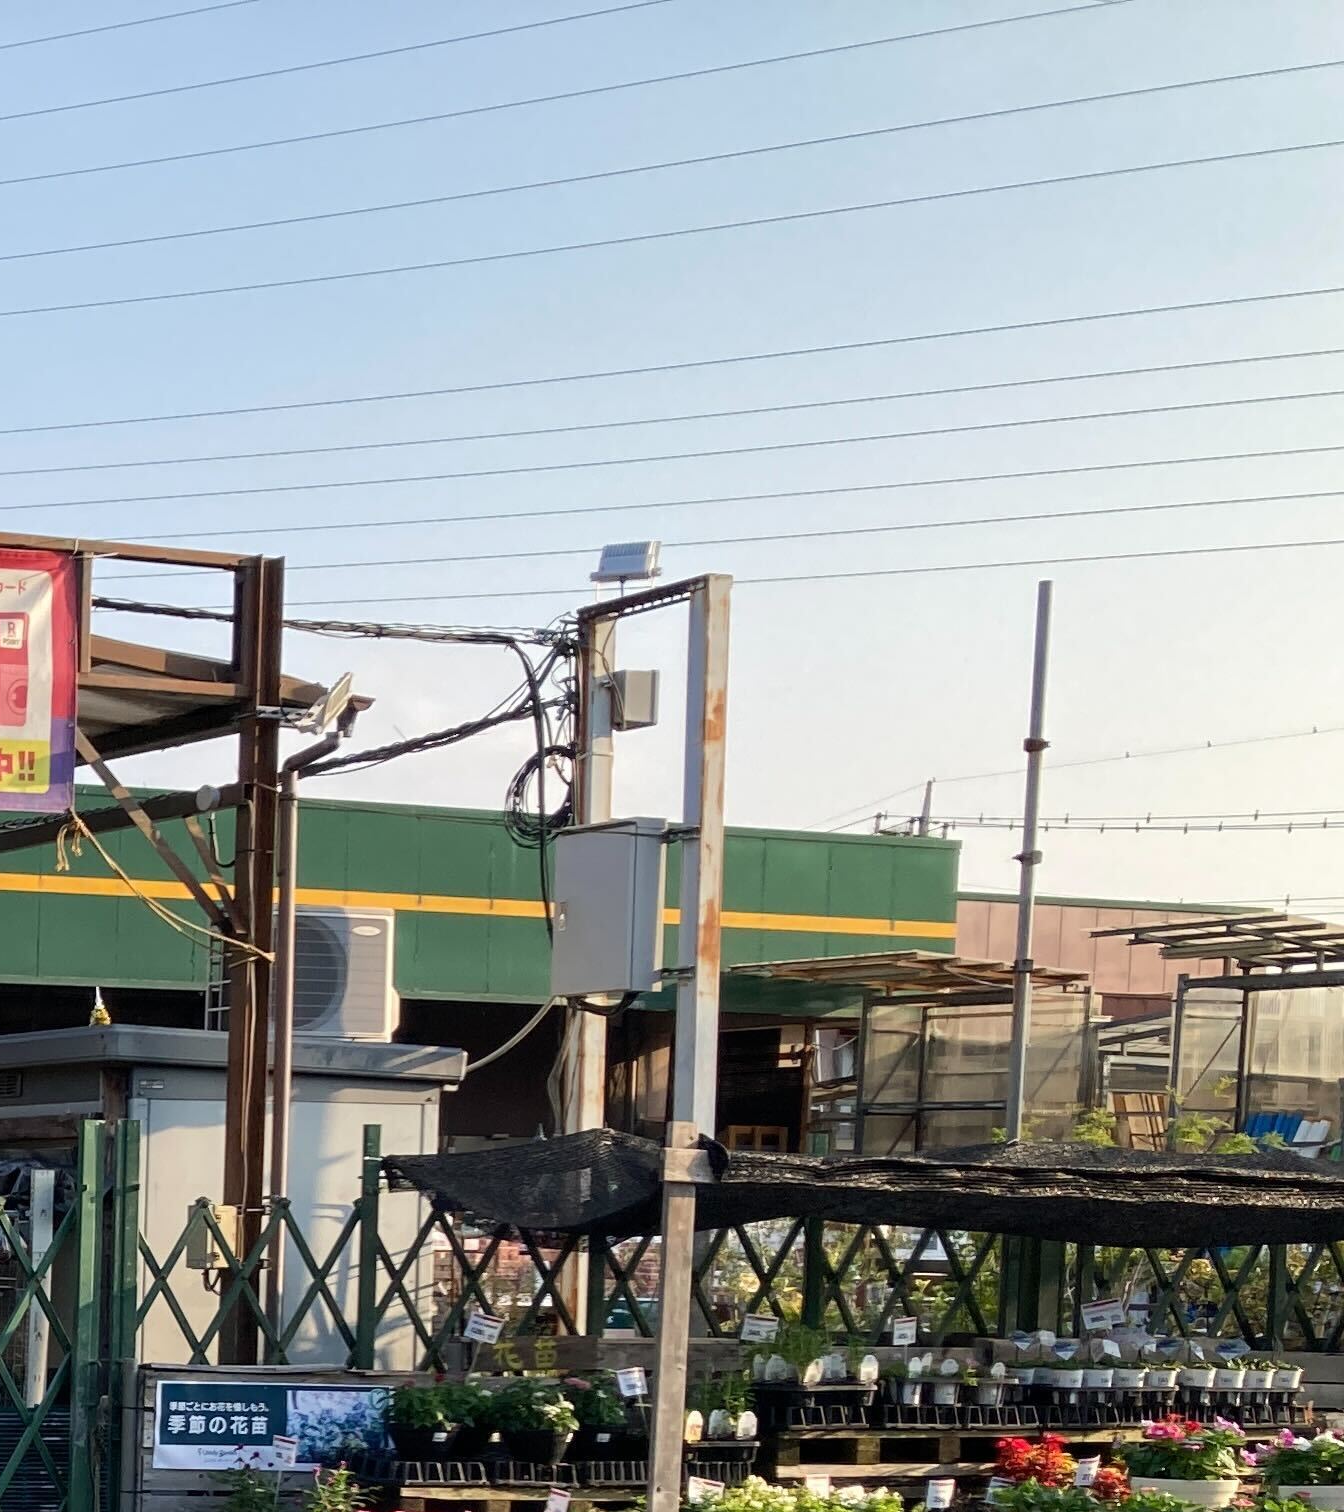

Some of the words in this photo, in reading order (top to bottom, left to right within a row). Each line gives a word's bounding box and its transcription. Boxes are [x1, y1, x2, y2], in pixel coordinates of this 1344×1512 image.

[167, 1414, 269, 1436] 季節の花苗
